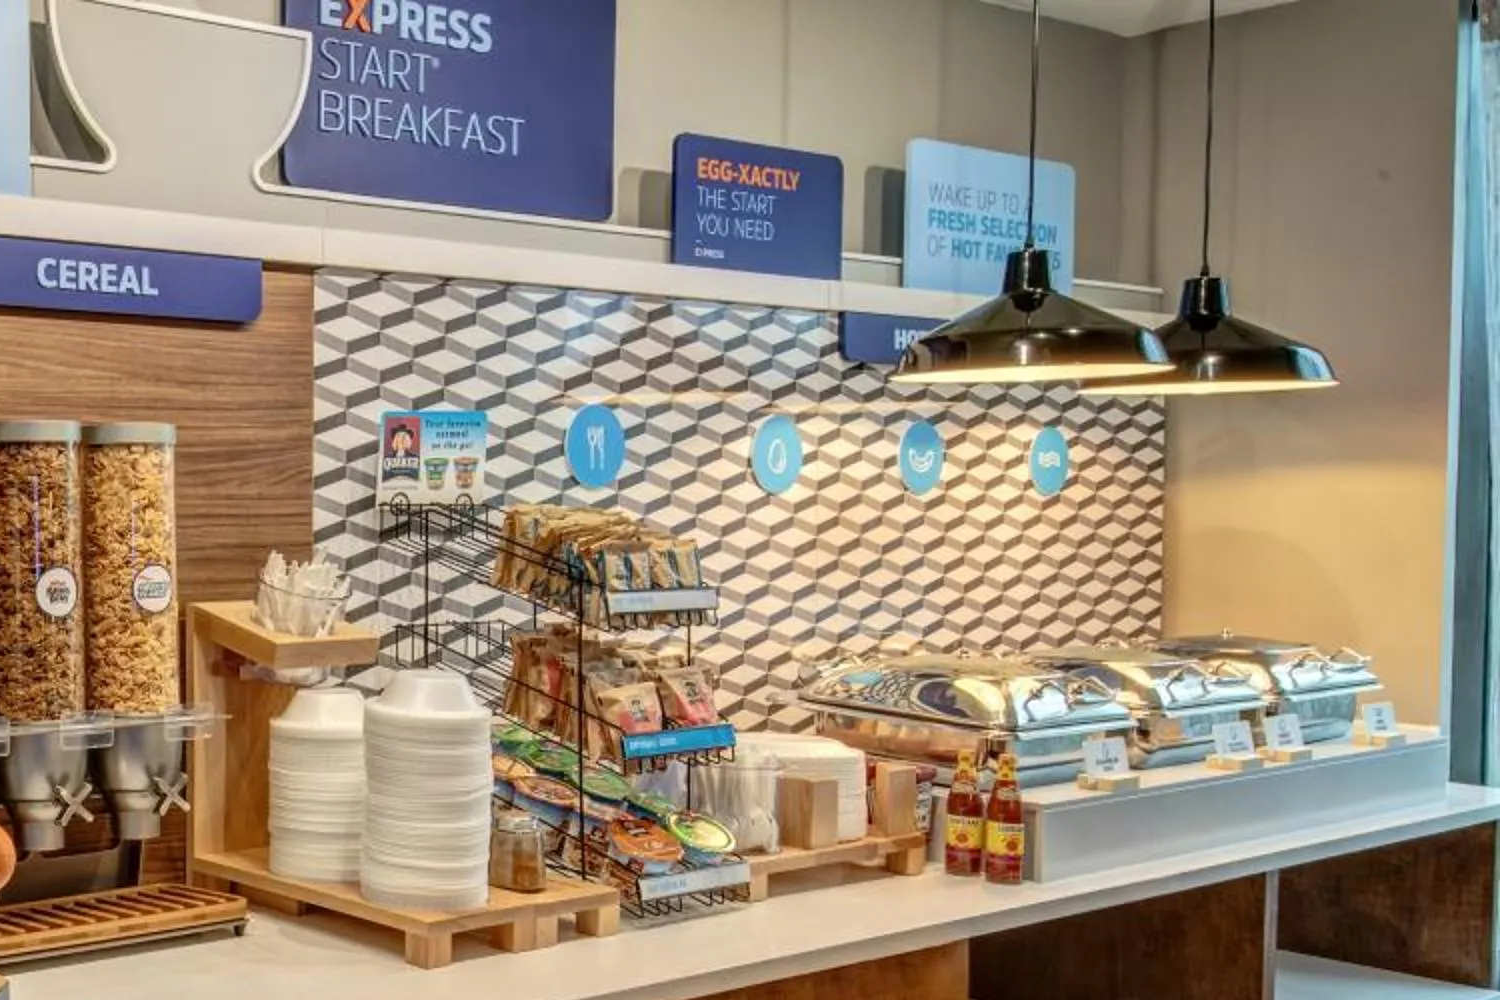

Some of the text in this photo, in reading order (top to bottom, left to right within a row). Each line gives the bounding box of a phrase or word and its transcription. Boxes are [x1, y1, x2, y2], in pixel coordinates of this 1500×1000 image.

[319, 0, 493, 53] EXPRESS
[318, 89, 526, 157] BREAKFAST
[697, 157, 800, 191] EGG-XACTLY
[697, 185, 778, 215] THE START
[928, 182, 1019, 214] WAKE UP TO
[696, 213, 775, 241] YOU NEED
[928, 208, 1057, 245] FRESH SELECON
[927, 234, 947, 256] OF
[951, 239, 981, 261] HOT
[36, 256, 160, 297] CEREAL
[894, 328, 925, 351] HO
